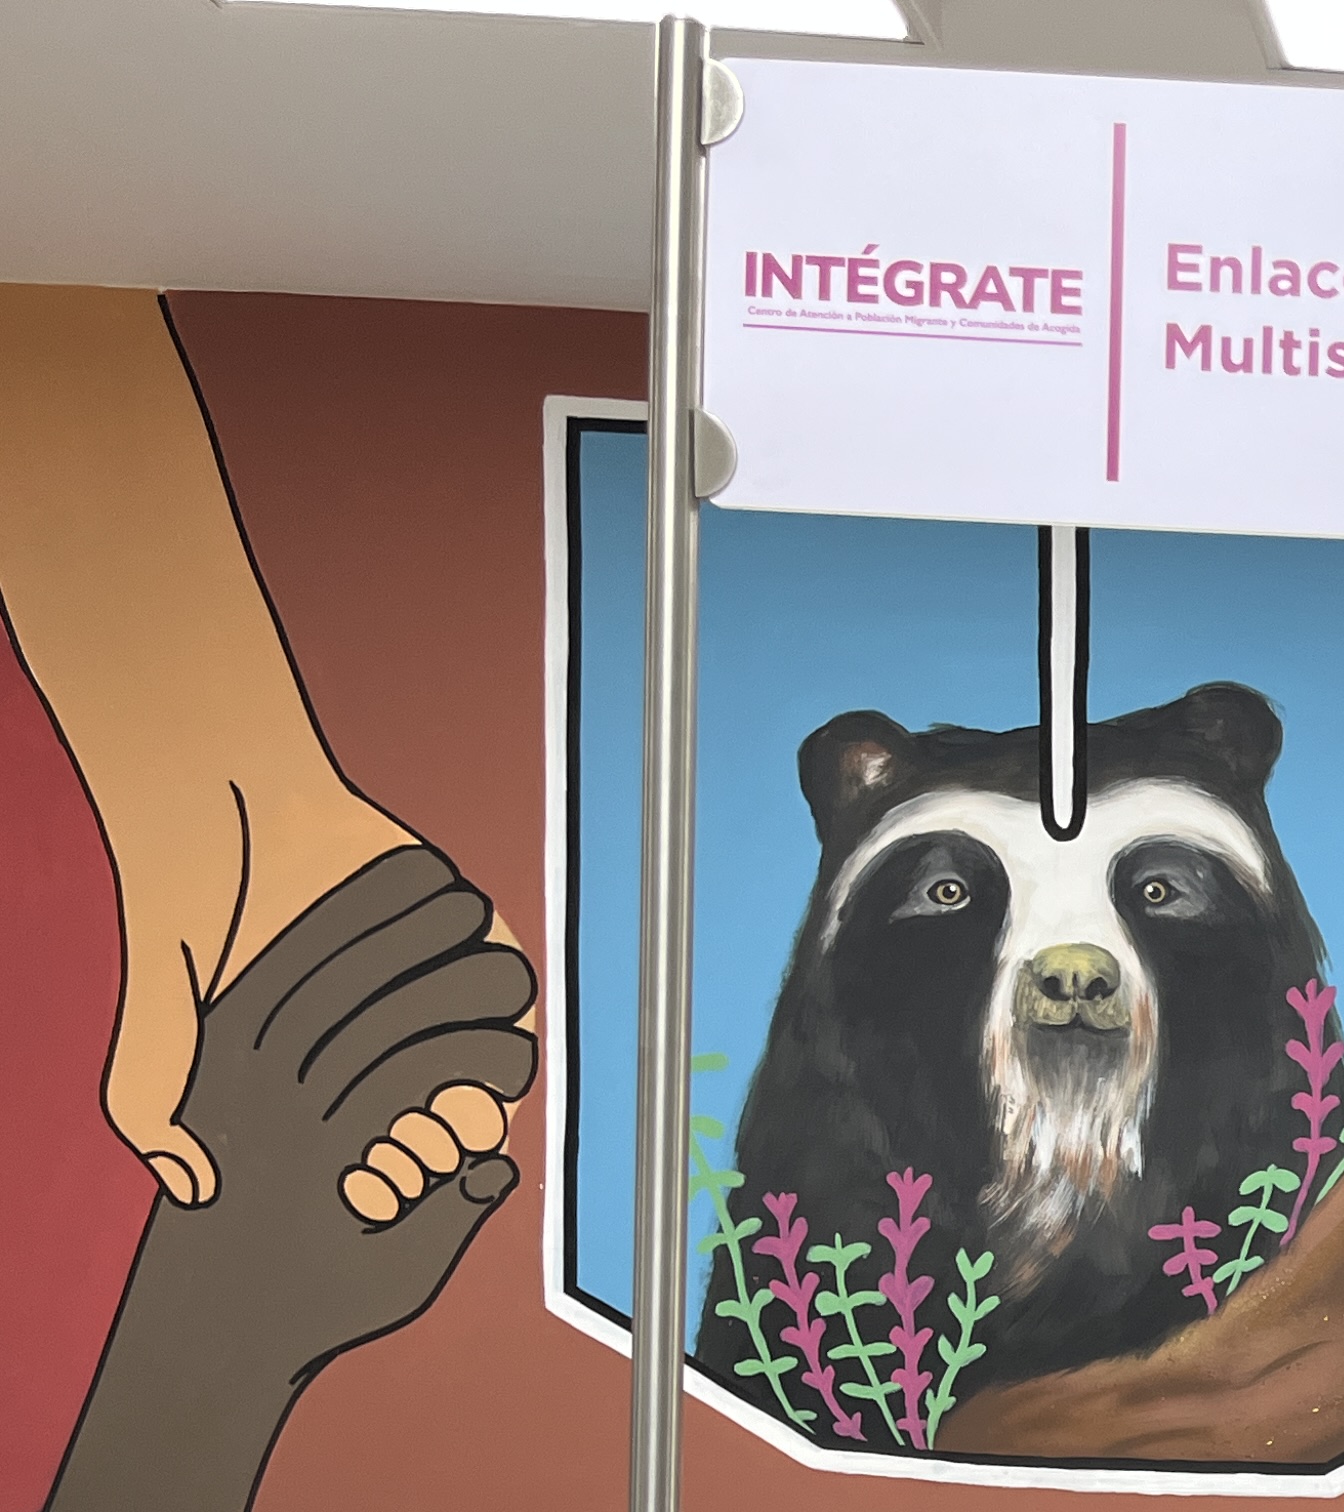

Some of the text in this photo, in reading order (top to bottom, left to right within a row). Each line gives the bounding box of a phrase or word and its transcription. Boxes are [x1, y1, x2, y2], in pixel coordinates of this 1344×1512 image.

[745, 243, 1083, 315] INTÉGRATE
[748, 306, 782, 316] Centro
[786, 308, 797, 317] de
[800, 310, 844, 320] Atención
[855, 312, 901, 323] Población
[905, 315, 947, 327] Migrante
[959, 318, 1024, 330] Comunidades
[1028, 323, 1039, 331] de
[1042, 323, 1080, 334] Acogida
